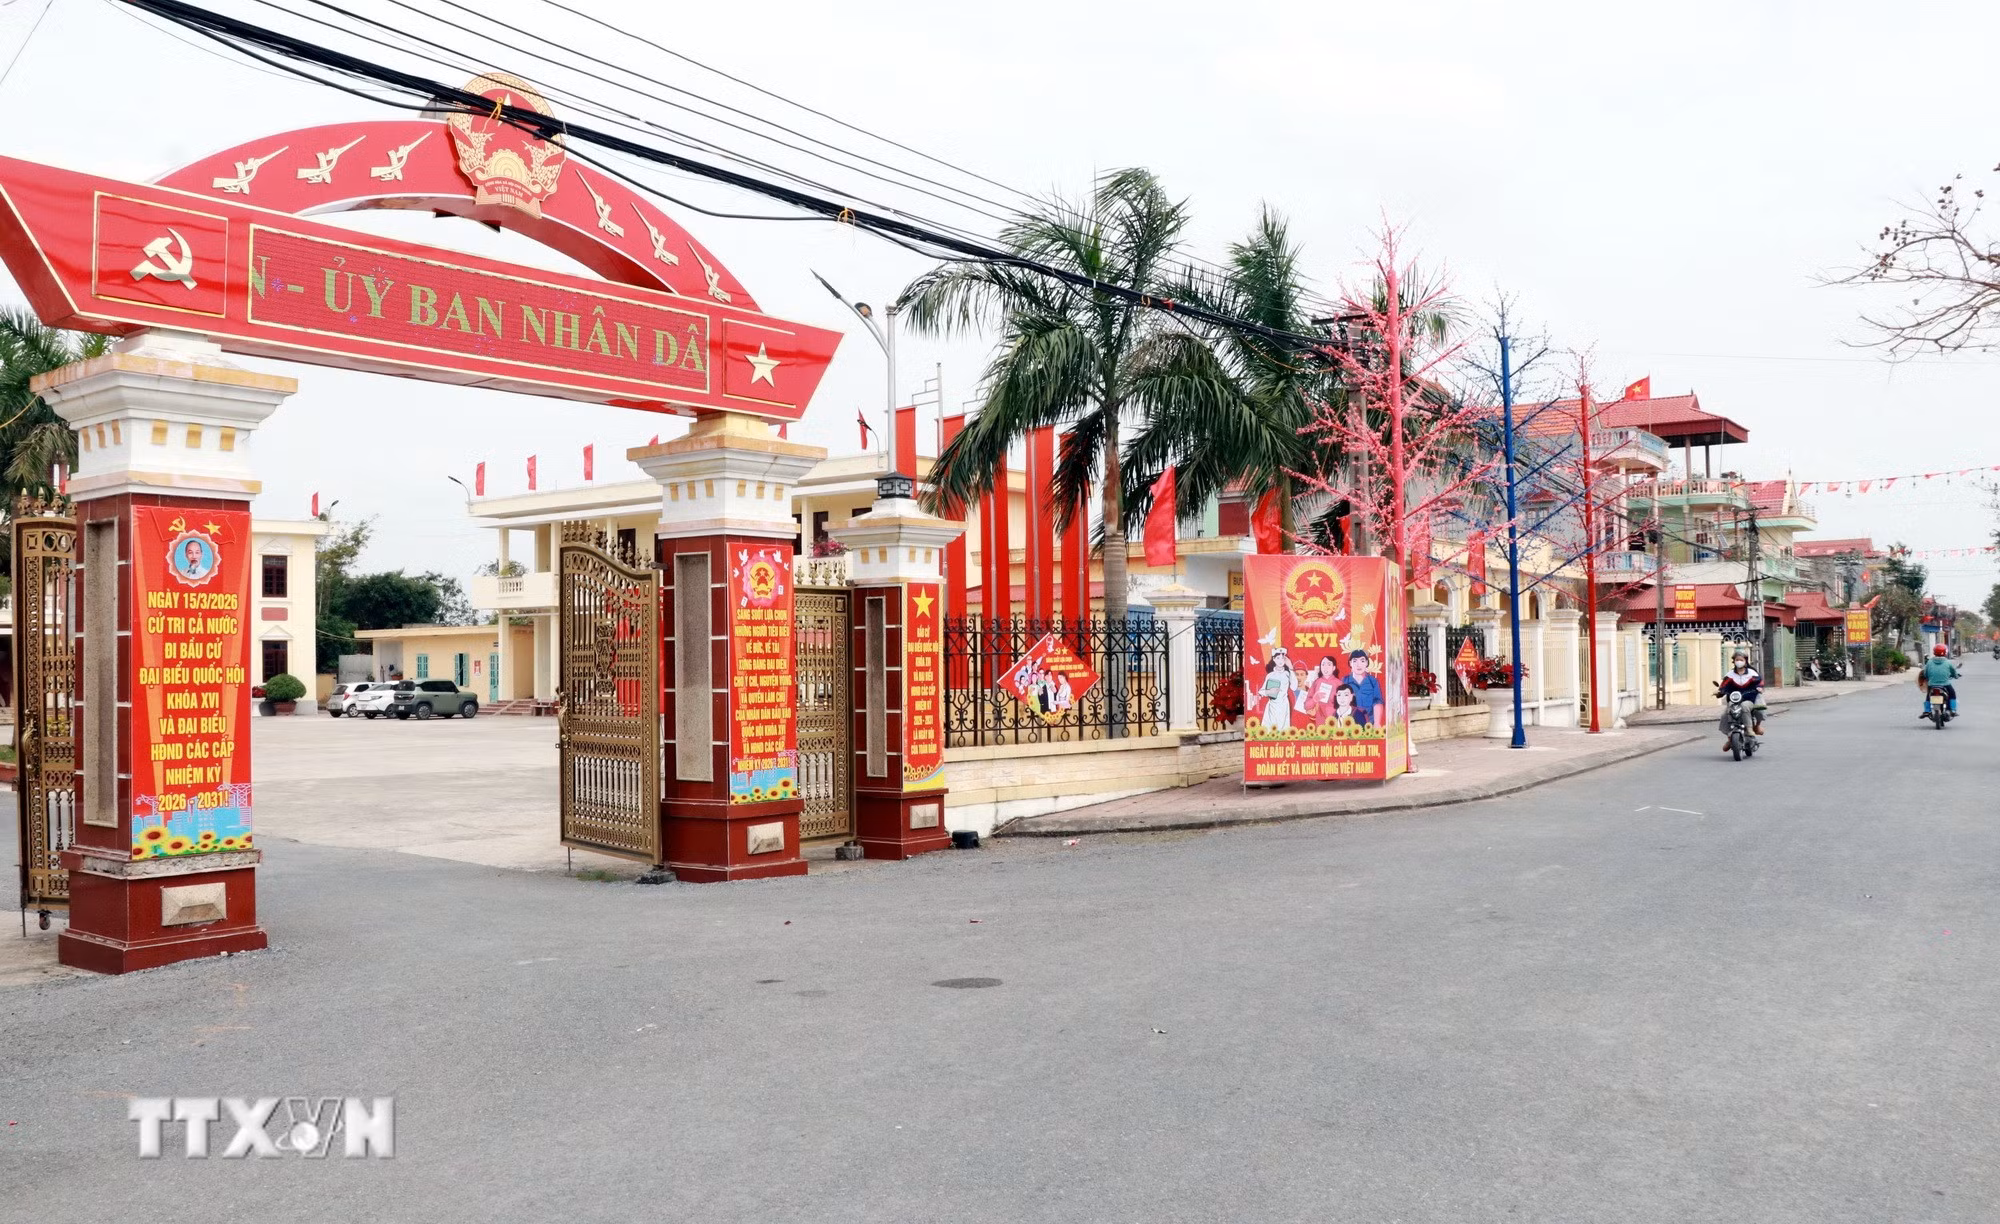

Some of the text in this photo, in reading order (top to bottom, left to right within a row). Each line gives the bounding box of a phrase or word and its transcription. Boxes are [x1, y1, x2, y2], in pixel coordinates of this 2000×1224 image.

[321, 256, 394, 318] ỦY
[407, 284, 506, 339] BAN
[520, 305, 641, 362] NHÂN
[653, 323, 707, 371] DÂ
[147, 588, 239, 610] NGÀY 15/3/2026
[147, 611, 238, 635] CỬ TRI CẢ NƯỚC
[164, 642, 177, 659] ĐI
[206, 637, 222, 659] CỬ
[1294, 632, 1338, 648] XVI
[139, 661, 245, 689] ĐẠI BIỂU QUỐC HỘI
[167, 689, 220, 710] KHÓA XVI
[159, 710, 227, 738] VÀ ĐẠI BIỂU
[151, 734, 235, 761] HĐND CÁC CẤP
[1250, 744, 1268, 758] NGÀY
[1285, 742, 1296, 758] CỬ
[1300, 743, 1320, 758] NGÀY
[1320, 743, 1332, 760] HỘI
[1333, 741, 1347, 757] CỦA
[1367, 744, 1380, 758] TIN,
[166, 763, 222, 788] NHIỆM KỲ
[1256, 760, 1374, 777] ĐOÀN KẾT VÀ KHÁT VỌNG VIỆT NAM!
[158, 793, 187, 812] 2026
[197, 790, 229, 809] 2031!
